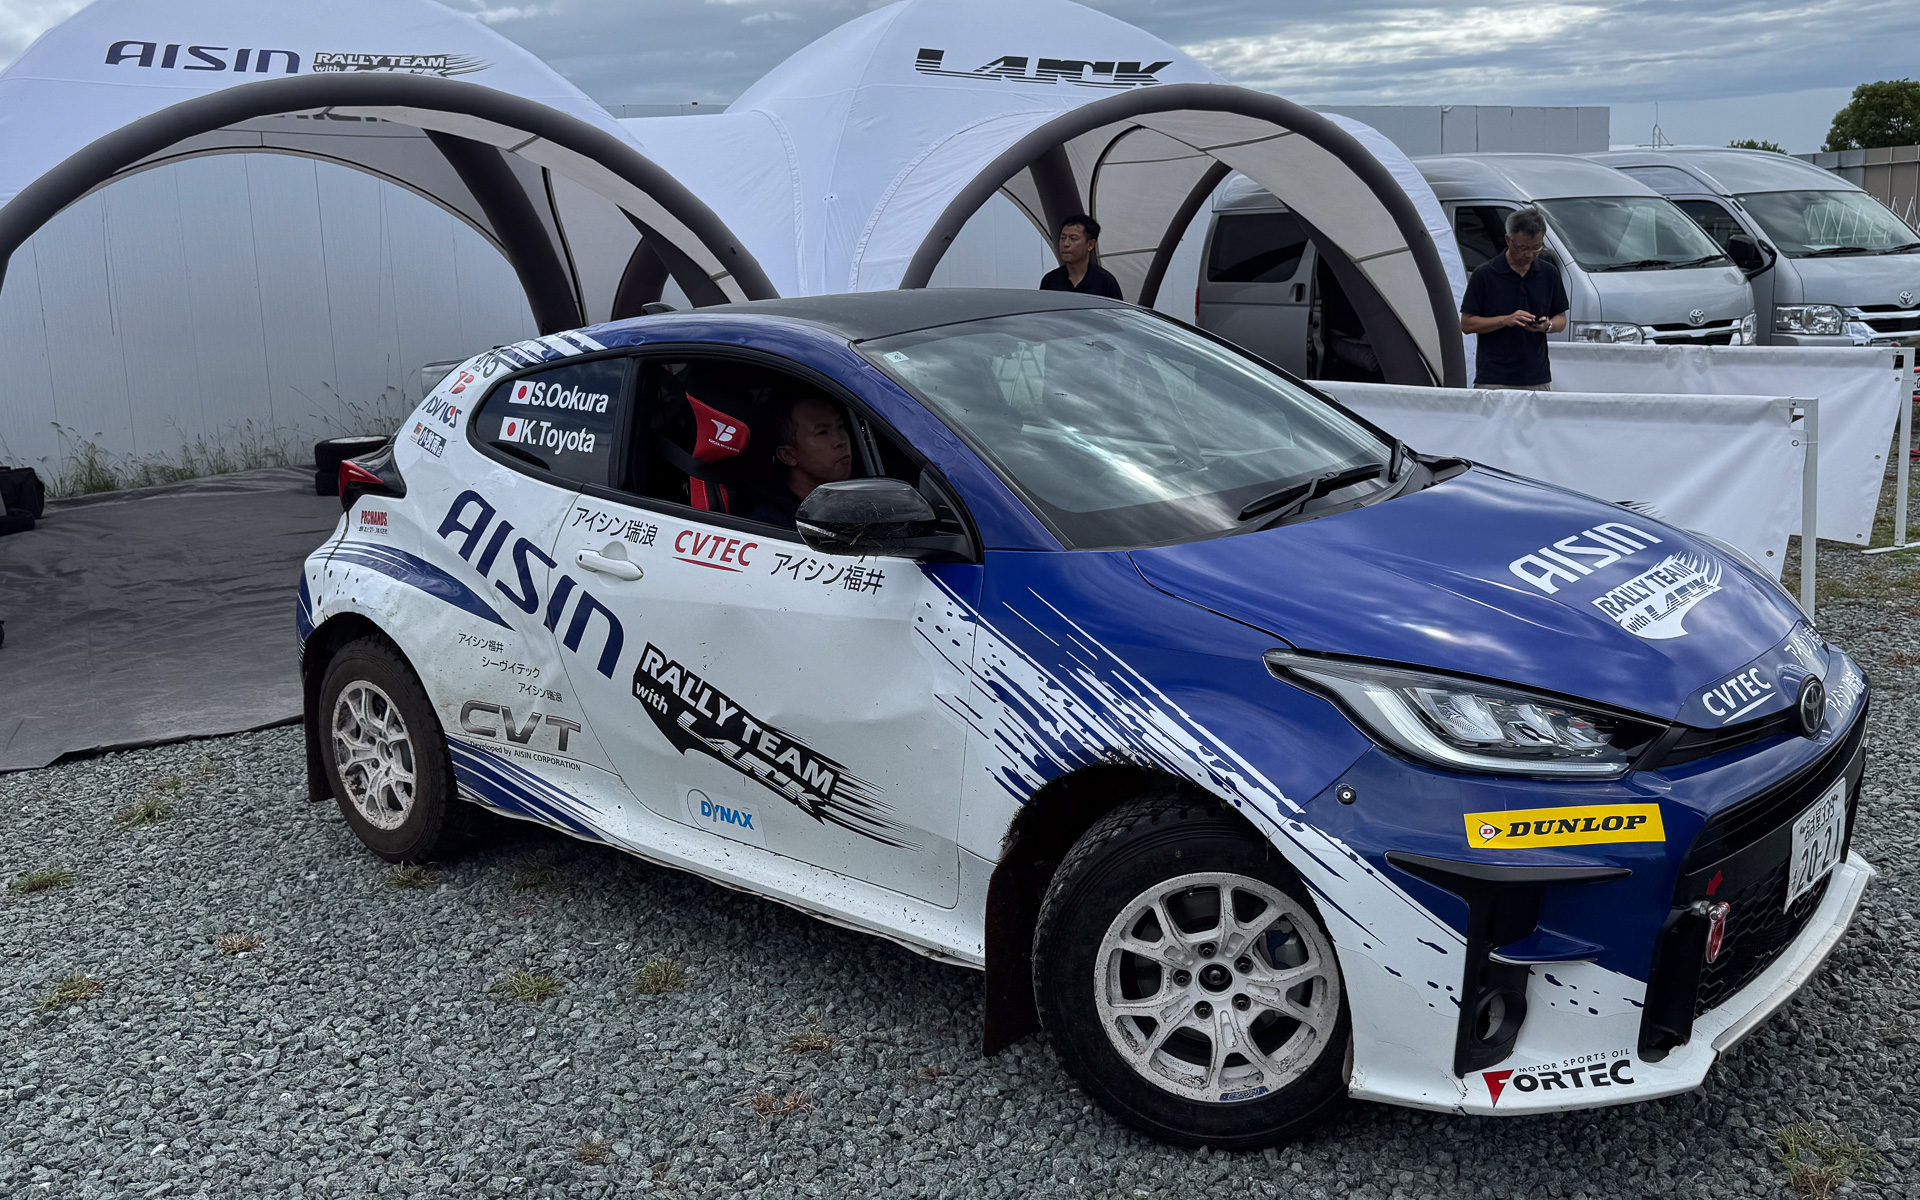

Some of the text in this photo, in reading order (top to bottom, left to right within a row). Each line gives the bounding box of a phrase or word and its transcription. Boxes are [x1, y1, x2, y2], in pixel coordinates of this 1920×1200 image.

[105, 40, 300, 74] AISIN
[315, 65, 341, 73] with
[316, 53, 446, 68] RALLY TEAM
[531, 381, 609, 413] S.Ookura
[520, 419, 596, 455] K.Toyota
[571, 506, 659, 547] アイシン瑞浪
[674, 530, 759, 567] CVTEC
[1508, 522, 1663, 595] AISIN
[436, 489, 625, 680] AISIN
[770, 552, 886, 595] アイシン福井
[1597, 561, 1695, 617] RALLY TEAM
[1626, 614, 1651, 633] with
[458, 632, 505, 654] アイシン福井
[635, 682, 669, 715] with
[1701, 667, 1772, 717] CVTEC
[460, 699, 582, 752] CVT
[641, 648, 835, 796] RALLY TEAM
[469, 740, 581, 772] Developed by AISIN CORPORATION
[701, 799, 755, 831] DYNAX
[1506, 815, 1648, 838] DUNLOP
[1518, 1048, 1631, 1074] MOTOR SPORTS OIL
[1482, 1059, 1635, 1108] FORTEC
